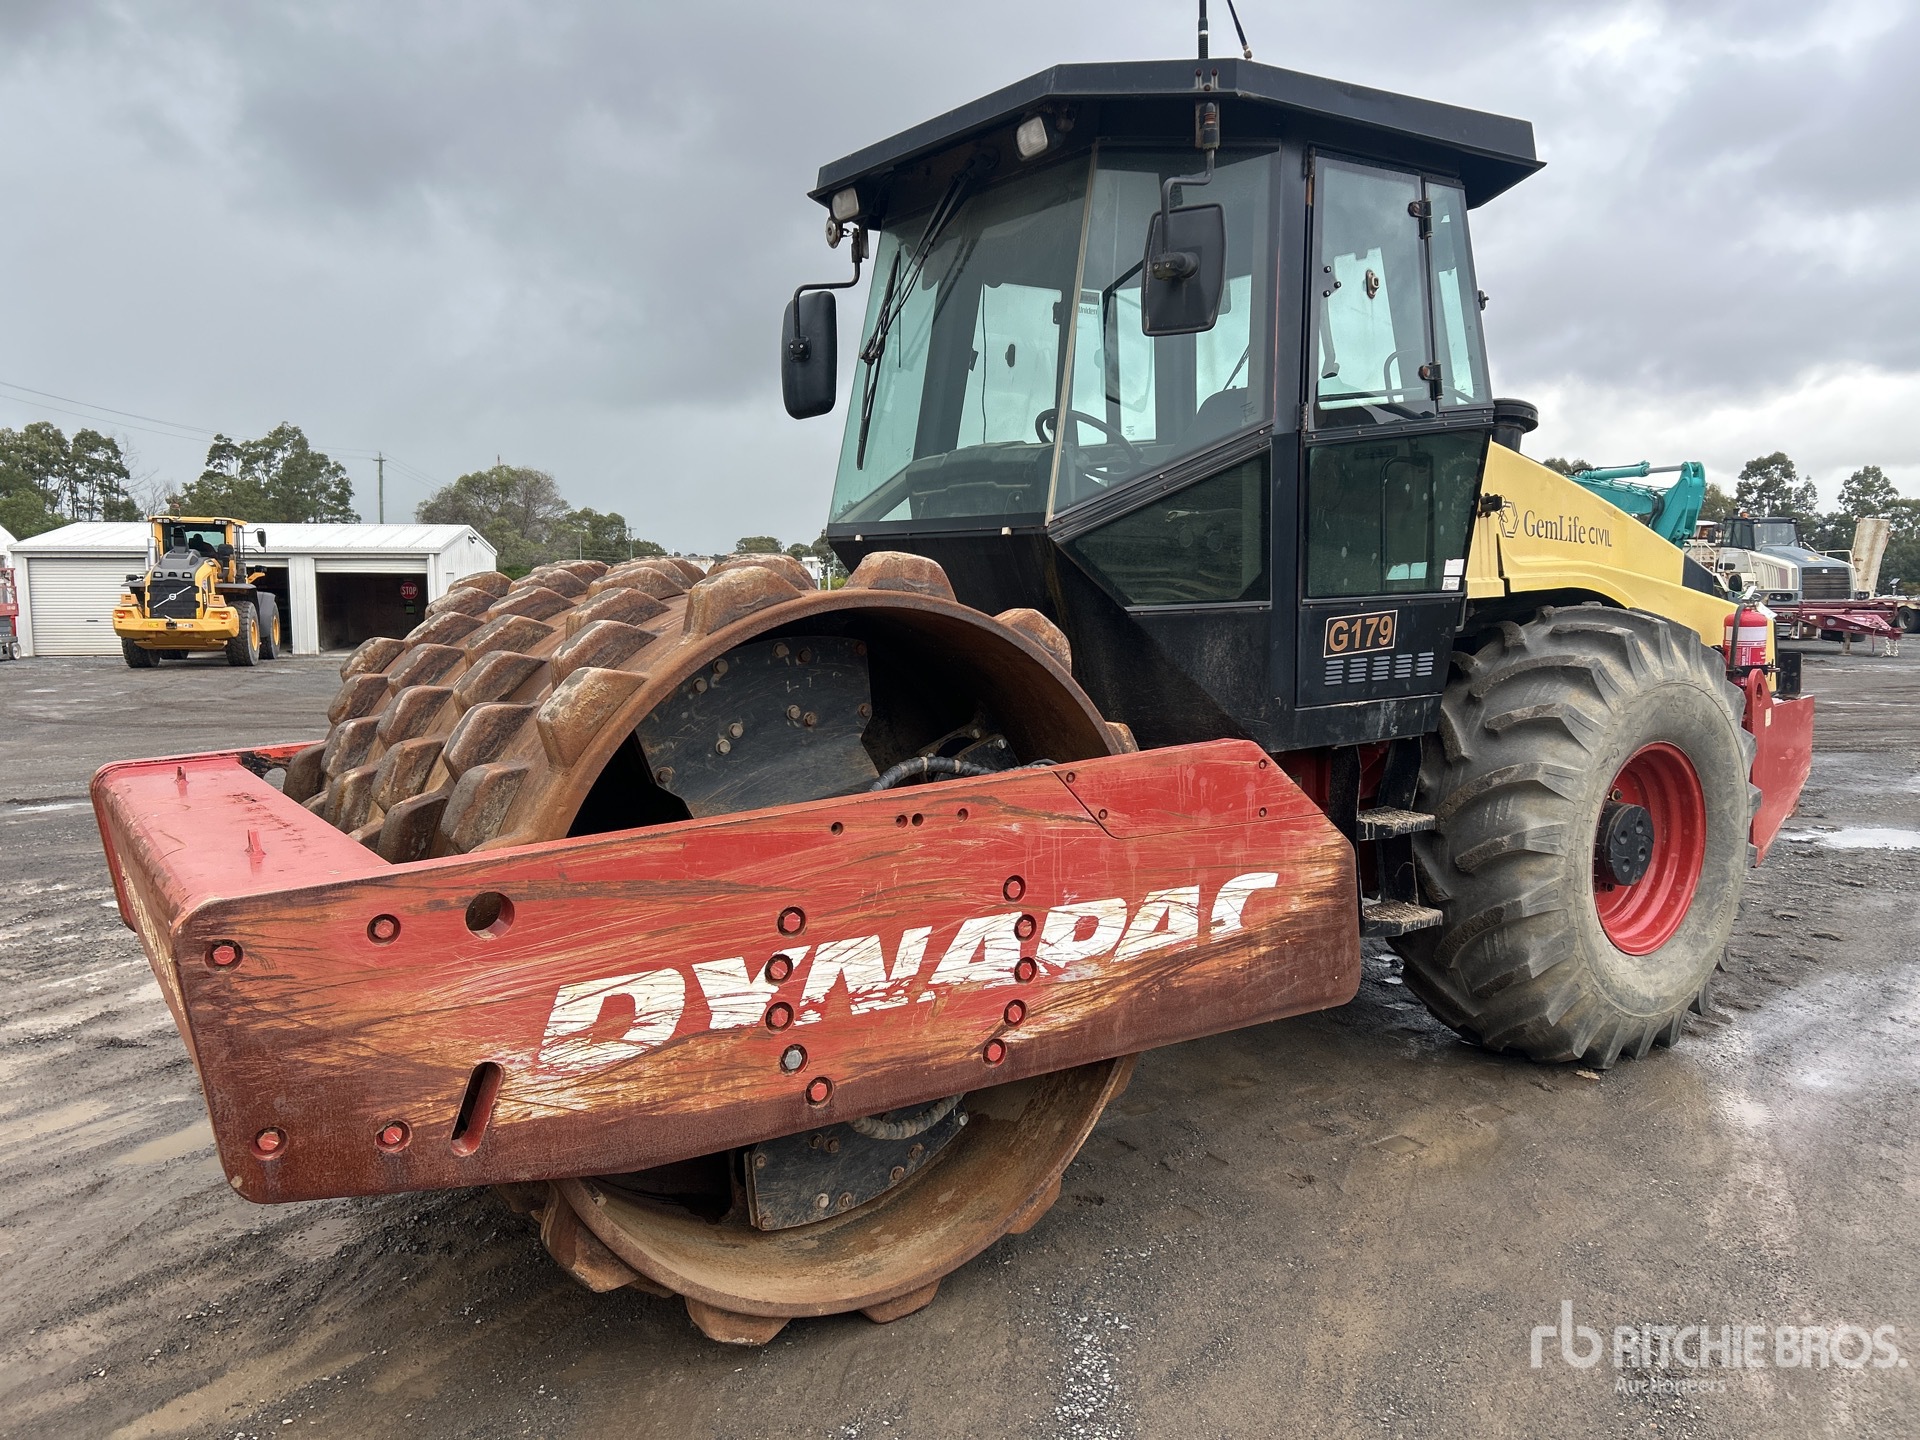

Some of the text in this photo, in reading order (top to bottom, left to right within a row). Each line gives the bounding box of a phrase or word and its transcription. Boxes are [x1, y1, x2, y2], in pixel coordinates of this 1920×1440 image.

[1523, 509, 1612, 547] GemLife CIVIL
[401, 586, 416, 595] STOP
[1329, 615, 1393, 652] G179
